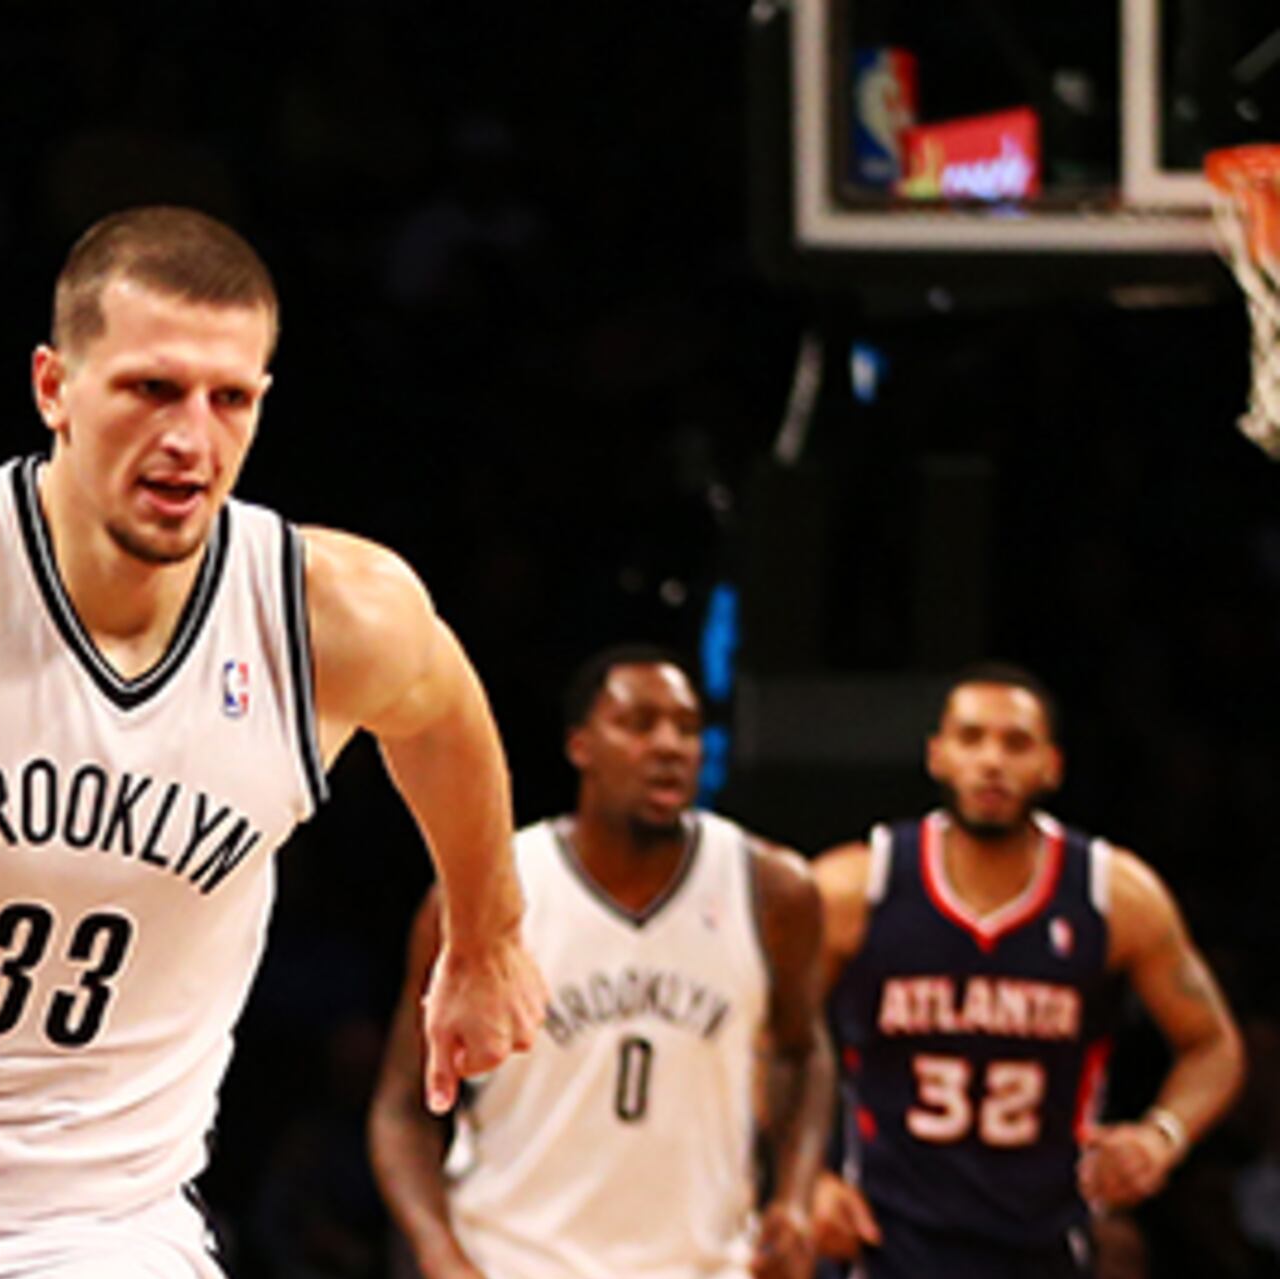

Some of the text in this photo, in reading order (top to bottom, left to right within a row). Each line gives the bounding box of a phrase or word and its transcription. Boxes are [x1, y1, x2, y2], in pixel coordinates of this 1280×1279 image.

[542, 966, 731, 1046] BROOKLYN
[877, 974, 1082, 1042] ATLANTA
[614, 1034, 653, 1124] 0
[905, 1054, 1047, 1149] 32
